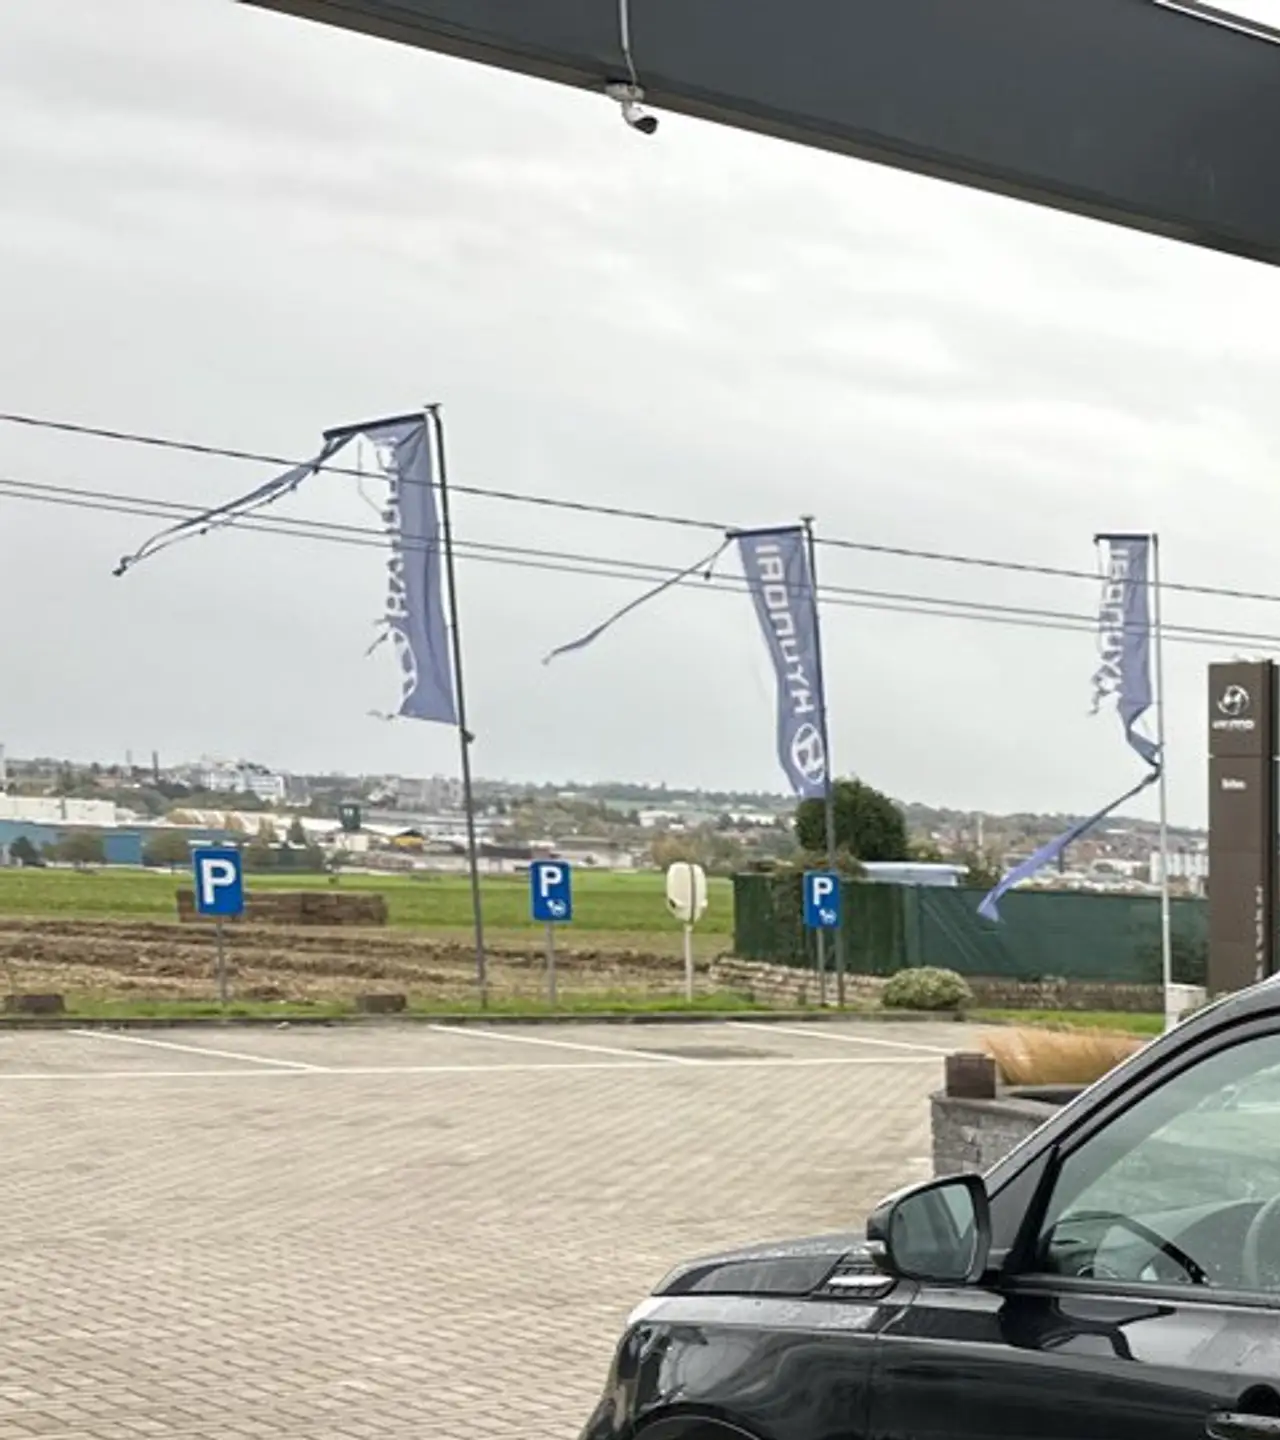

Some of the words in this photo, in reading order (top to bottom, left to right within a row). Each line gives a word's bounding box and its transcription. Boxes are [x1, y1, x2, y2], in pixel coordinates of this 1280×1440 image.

[200, 858, 237, 906] P
[539, 866, 563, 898] P
[813, 877, 834, 905] P
